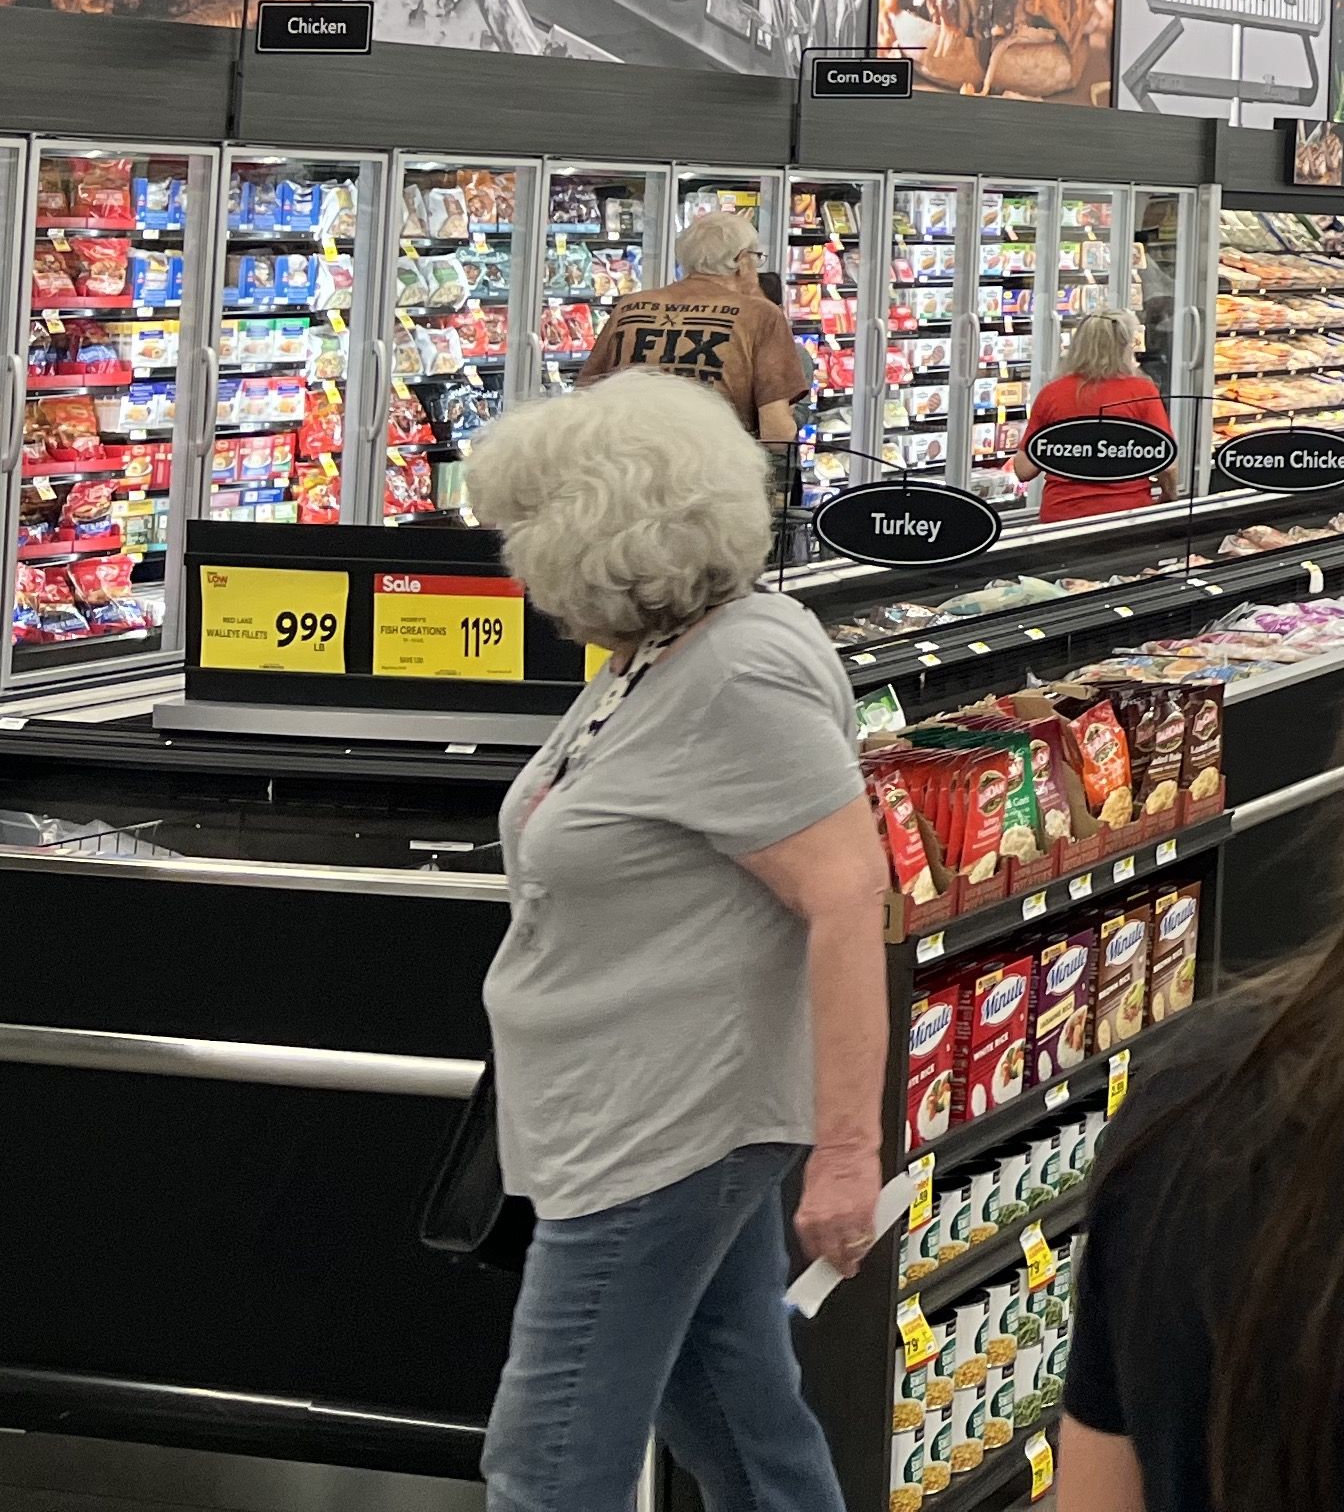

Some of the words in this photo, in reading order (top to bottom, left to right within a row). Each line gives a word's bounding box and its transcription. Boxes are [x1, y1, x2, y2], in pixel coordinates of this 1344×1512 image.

[287, 17, 347, 36] Chicken
[826, 69, 860, 86] Corn
[862, 69, 898, 88] Dogs
[621, 301, 660, 312] THAT'S
[665, 303, 710, 313] WHAT
[720, 305, 741, 316] DO
[629, 328, 731, 369] FIX
[1037, 439, 1093, 458] Frozen
[1097, 439, 1166, 459] Seafood
[1225, 449, 1286, 469] Frozen
[871, 512, 943, 543] Turkey
[382, 575, 422, 593] Sale
[206, 628, 240, 639] WALLEYE
[275, 611, 338, 648] 999
[380, 625, 398, 635] FISH
[400, 625, 447, 636] CREATIONS
[460, 616, 503, 658] 1199
[1163, 900, 1196, 936] Minute
[1109, 923, 1145, 961] Minute
[1051, 950, 1088, 989] Minute
[984, 978, 1025, 1020] Minute
